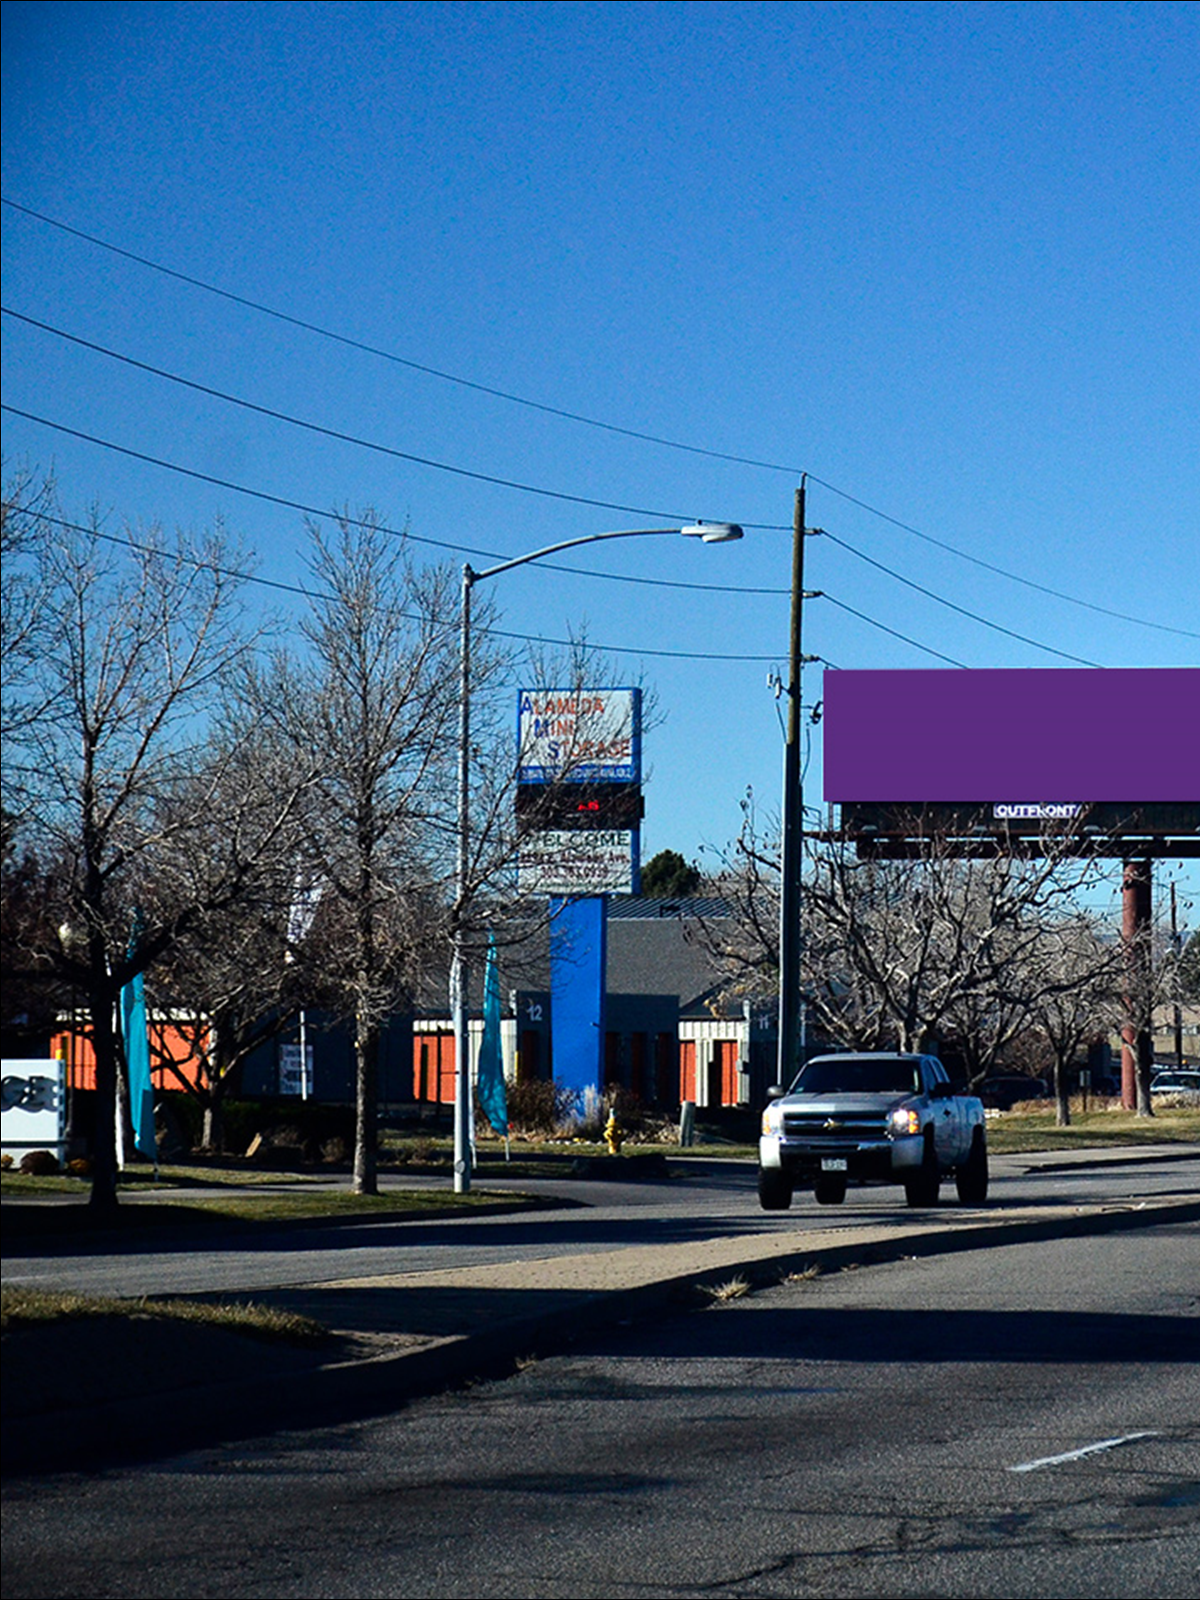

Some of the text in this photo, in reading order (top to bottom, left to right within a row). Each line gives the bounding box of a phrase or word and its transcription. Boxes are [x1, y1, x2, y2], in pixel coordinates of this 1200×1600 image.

[520, 696, 604, 715] ALAMEDA
[534, 718, 574, 738] MINI
[547, 739, 631, 759] STORAGE
